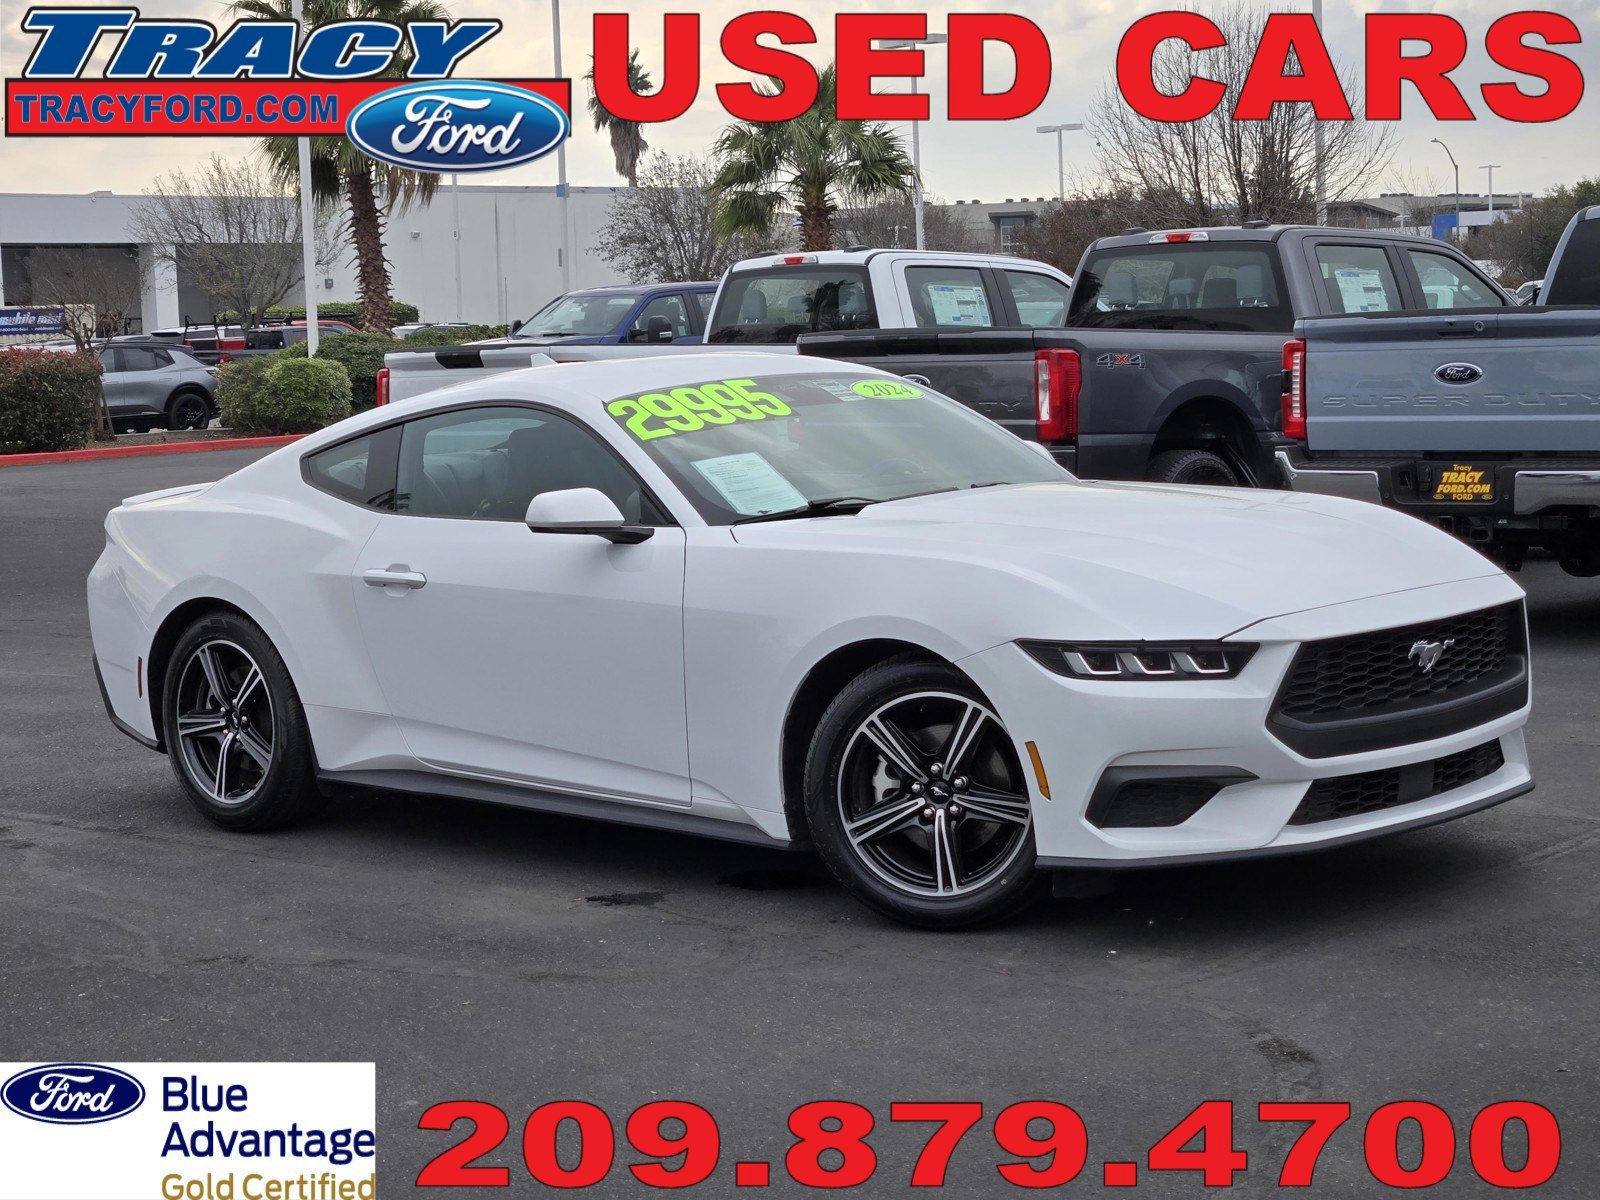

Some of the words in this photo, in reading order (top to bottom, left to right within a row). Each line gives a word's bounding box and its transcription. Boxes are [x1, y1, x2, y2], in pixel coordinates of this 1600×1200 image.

[1445, 366, 1471, 380] Ford
[863, 383, 913, 397] 2024
[1323, 394, 1469, 408] SUPER
[607, 379, 792, 441] 29995
[1453, 464, 1472, 472] Tracy
[1441, 471, 1485, 483] TRACY
[1436, 484, 1491, 493] FORD.COM
